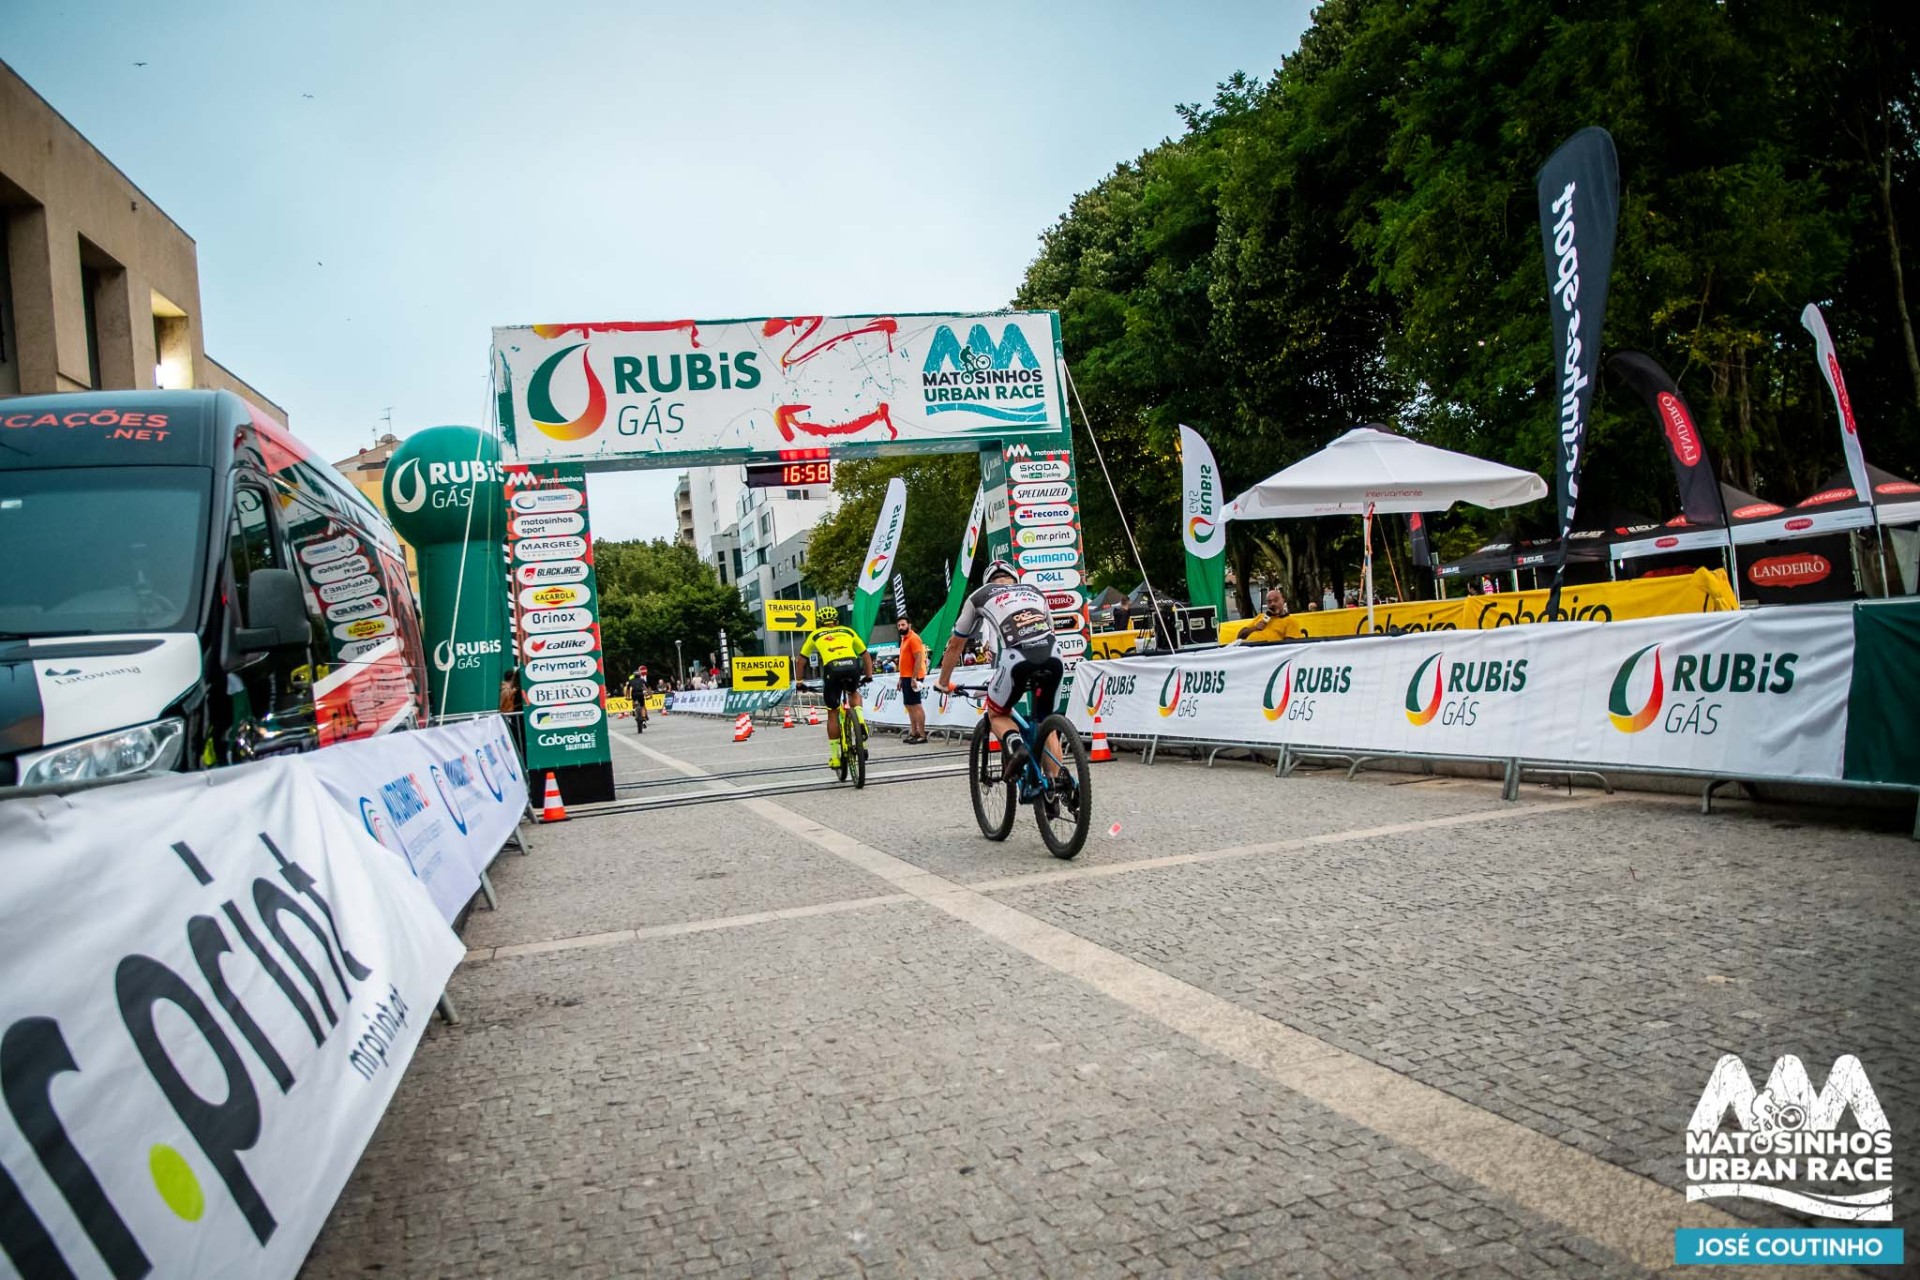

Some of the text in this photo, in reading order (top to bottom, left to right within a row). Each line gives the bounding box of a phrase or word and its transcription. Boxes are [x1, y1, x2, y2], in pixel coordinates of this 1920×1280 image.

[922, 368, 1043, 386] MATOSINHOS
[923, 384, 1045, 403] URBAN RACE
[0, 409, 169, 429] CAÇÕES
[617, 397, 686, 436] GÁS
[105, 429, 171, 441] .NET
[782, 464, 829, 483] 16:58
[432, 485, 472, 509] GÁS
[1017, 487, 1068, 499] SPECIALIZED
[1033, 509, 1069, 518] reconco
[1036, 531, 1071, 541] mr.print
[521, 540, 580, 551] MARGRES
[1022, 552, 1075, 565] SHIMANO
[537, 566, 582, 577] BLACKJACK
[1036, 572, 1064, 583] DELL
[532, 613, 577, 625] Brinox
[547, 641, 586, 650] catlike
[1177, 696, 1197, 718] GÁS
[1289, 696, 1316, 721] GÁS
[1442, 696, 1477, 727] GÁS
[1665, 697, 1722, 735] GÁS
